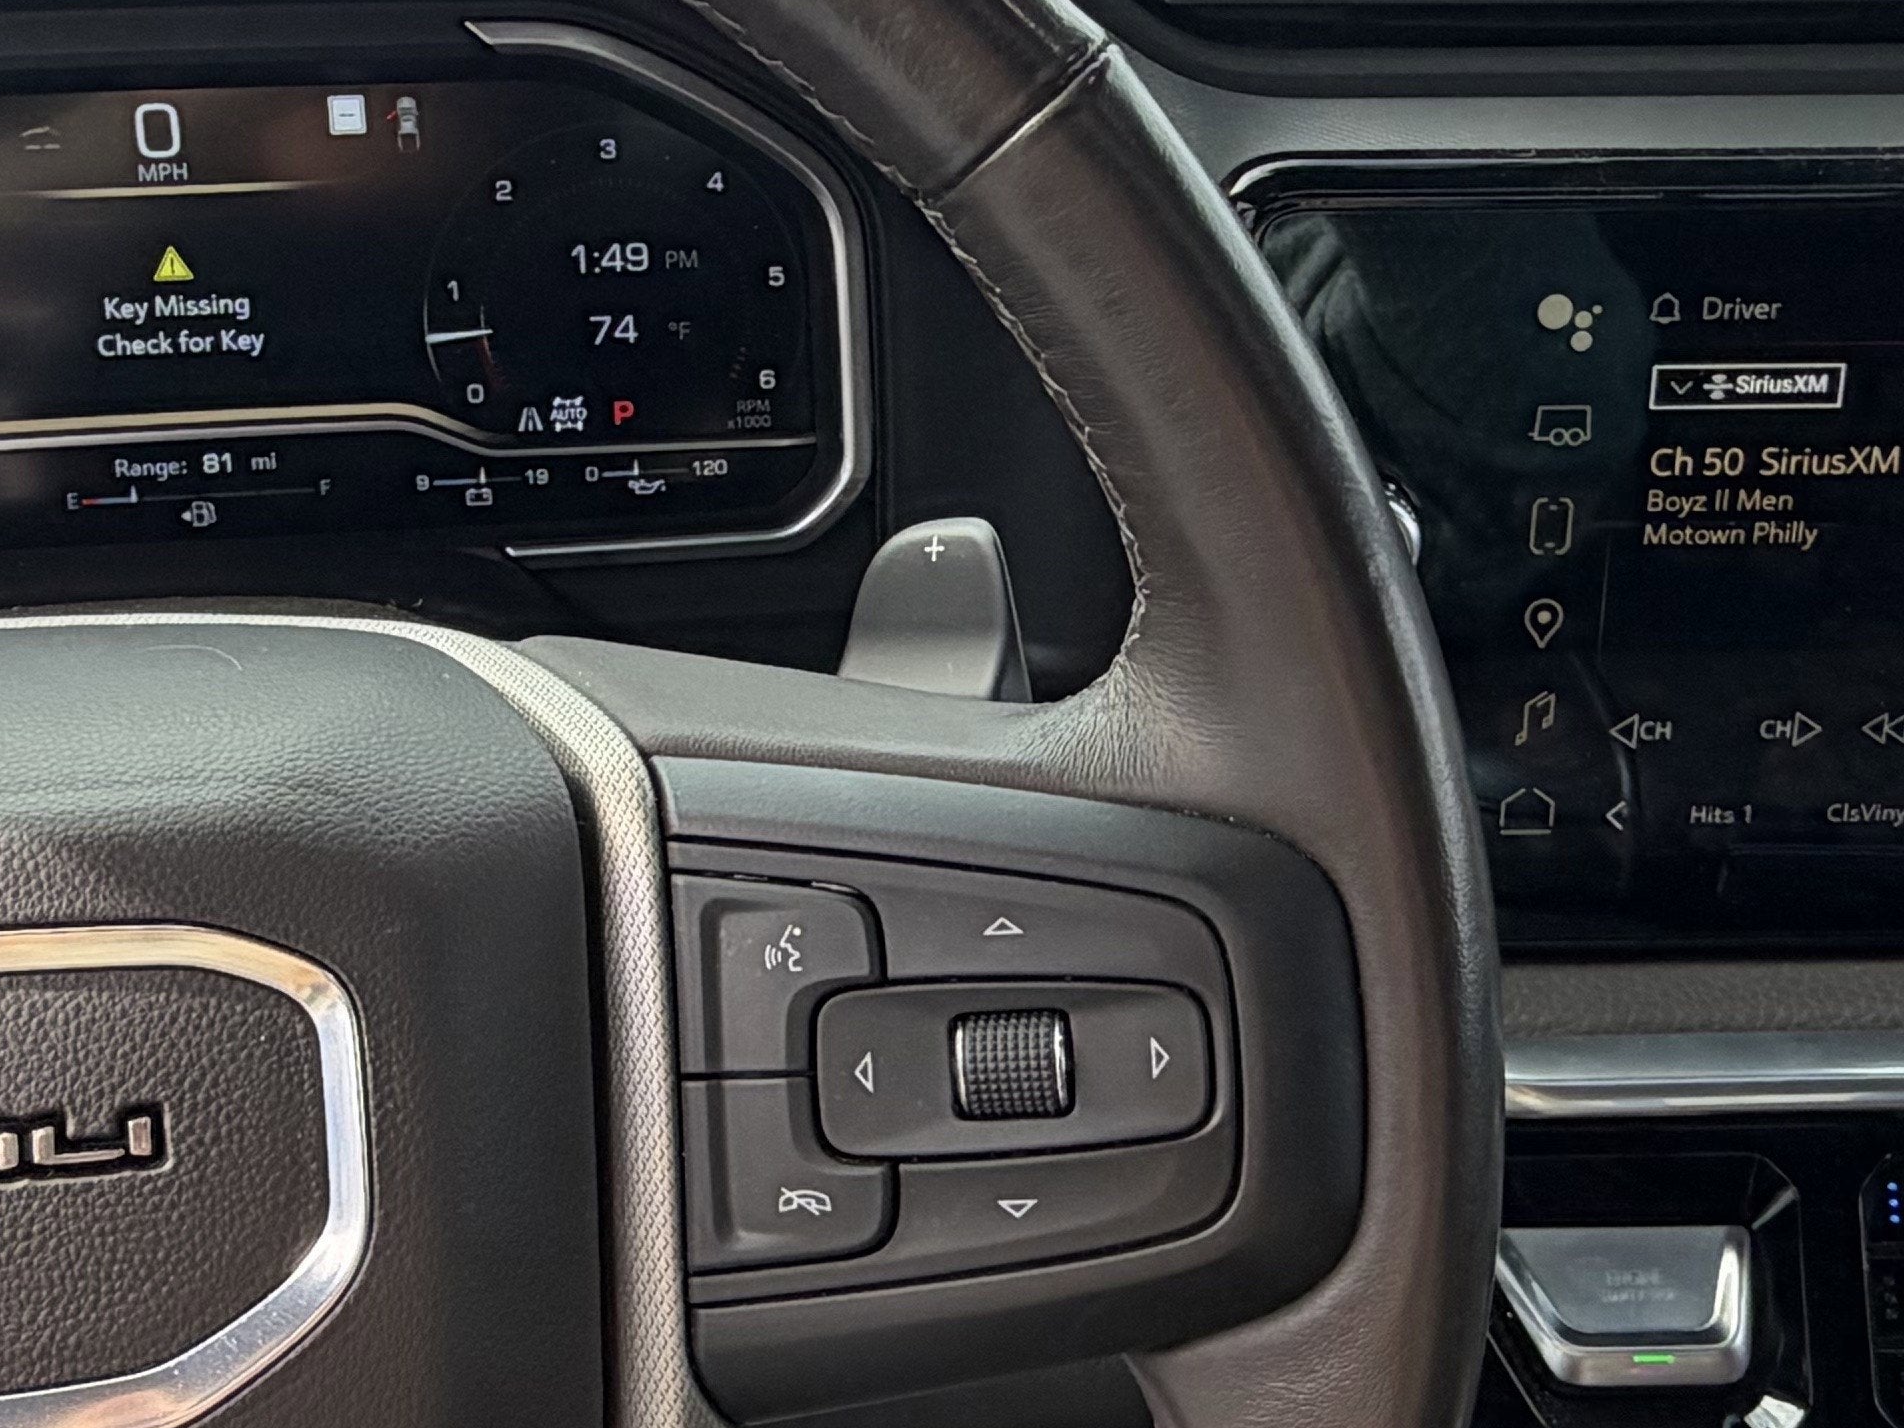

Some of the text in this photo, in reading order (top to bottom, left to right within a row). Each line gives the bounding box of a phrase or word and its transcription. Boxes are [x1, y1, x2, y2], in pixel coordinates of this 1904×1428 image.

[134, 102, 182, 158] 0
[599, 139, 617, 161] 3
[137, 163, 189, 182] MPH
[705, 172, 726, 193] 4
[495, 180, 513, 202] 2
[570, 242, 698, 274] 1:49 PM
[768, 266, 786, 288] 5
[447, 280, 460, 302] 1
[103, 294, 252, 326] Key Missing
[1701, 296, 1783, 322] Driver
[588, 314, 638, 346] 74
[97, 329, 266, 358] Check for Key
[758, 369, 777, 391] 6
[1734, 373, 1830, 395] SiriusXM
[466, 383, 485, 404] 0
[550, 407, 588, 422] AUTO
[613, 400, 635, 426] P
[736, 398, 772, 413] RPM
[114, 452, 277, 483] Range: 81 mi
[692, 458, 728, 476] 120
[1650, 446, 1694, 477] Ch
[1703, 446, 1745, 477] 50
[1759, 445, 1901, 476] SiriusXM
[525, 468, 549, 486] 19
[584, 466, 600, 483] 0
[319, 479, 332, 496] F
[66, 492, 81, 510] E
[1647, 488, 1707, 515] Boyz
[1736, 489, 1795, 513] Men
[1643, 521, 1819, 551] Motown Philly
[1639, 720, 1673, 742] CH
[1759, 719, 1792, 740] CH
[1689, 804, 1753, 825] Hits 1
